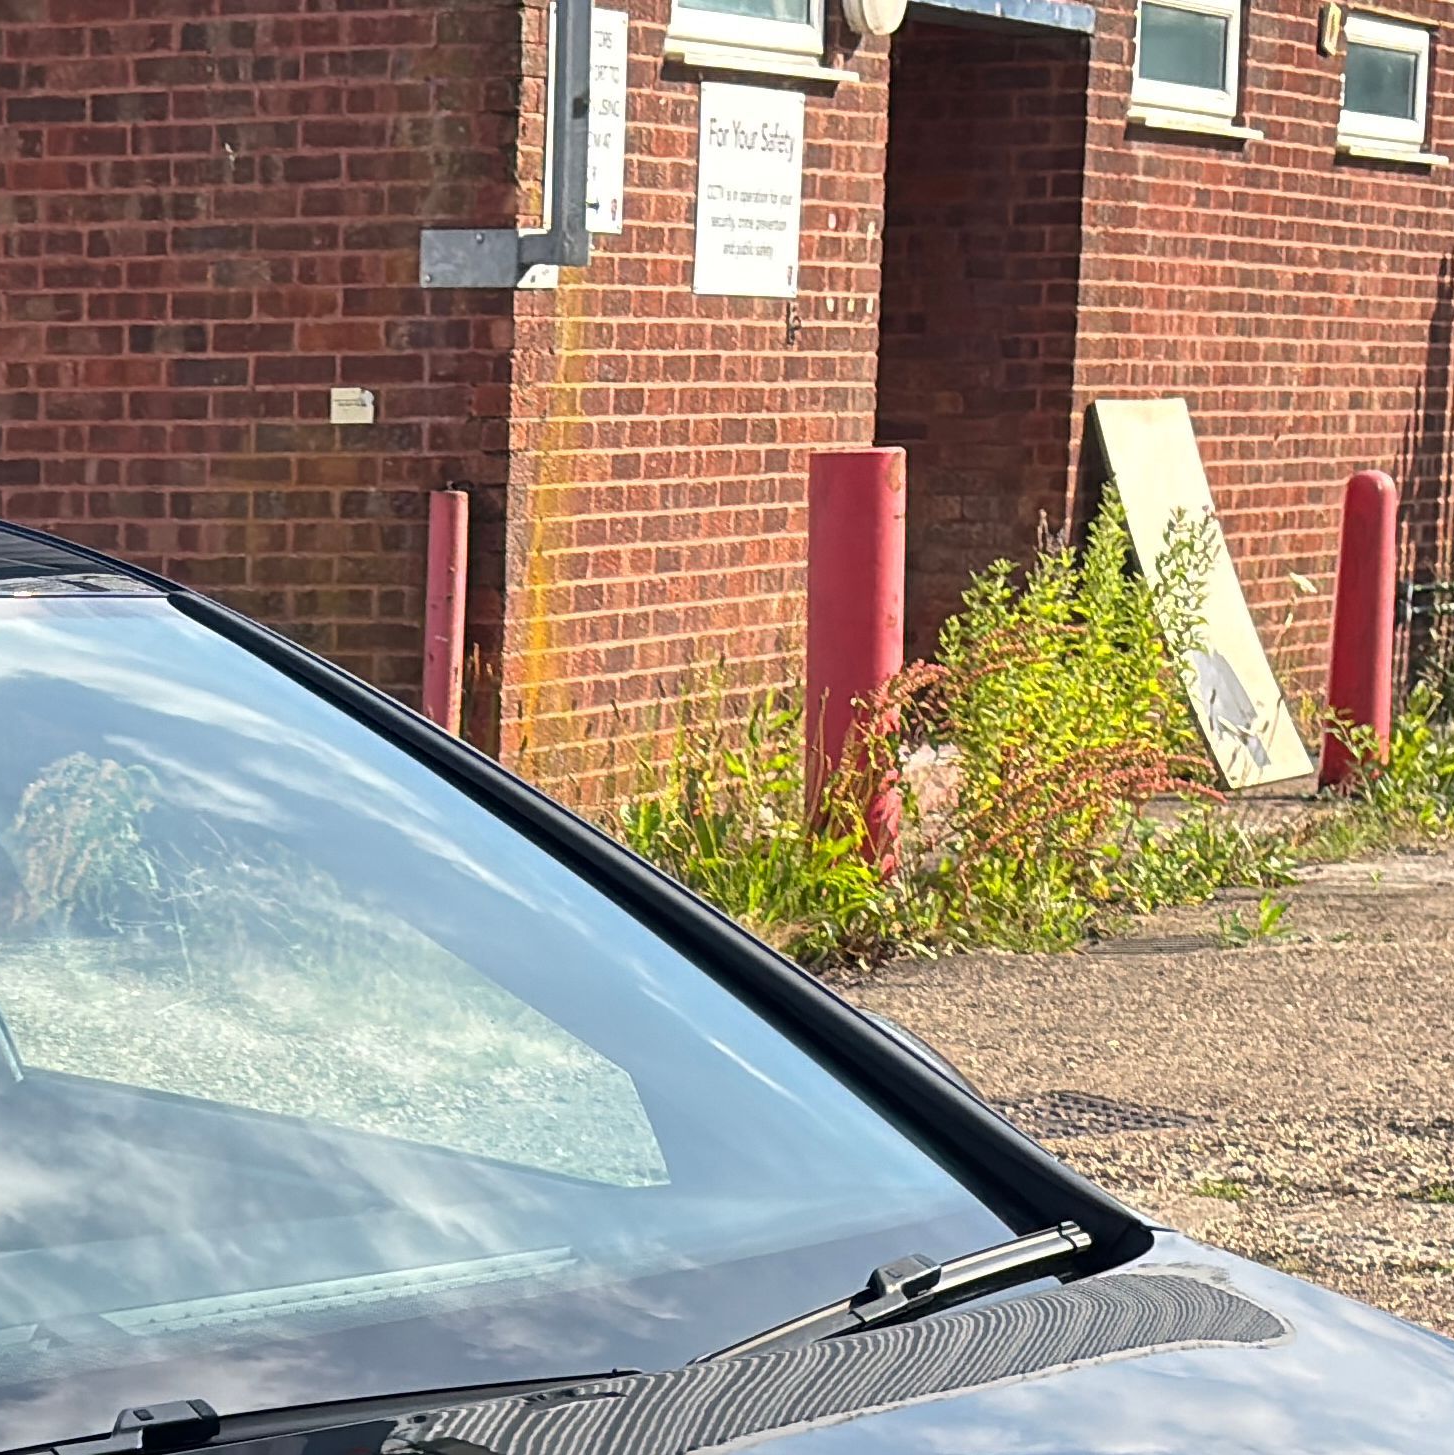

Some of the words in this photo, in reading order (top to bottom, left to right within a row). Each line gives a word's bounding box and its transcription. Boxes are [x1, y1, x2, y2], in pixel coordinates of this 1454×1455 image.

[709, 118, 729, 147] For
[733, 120, 758, 150] Your
[761, 123, 795, 162] Safety
